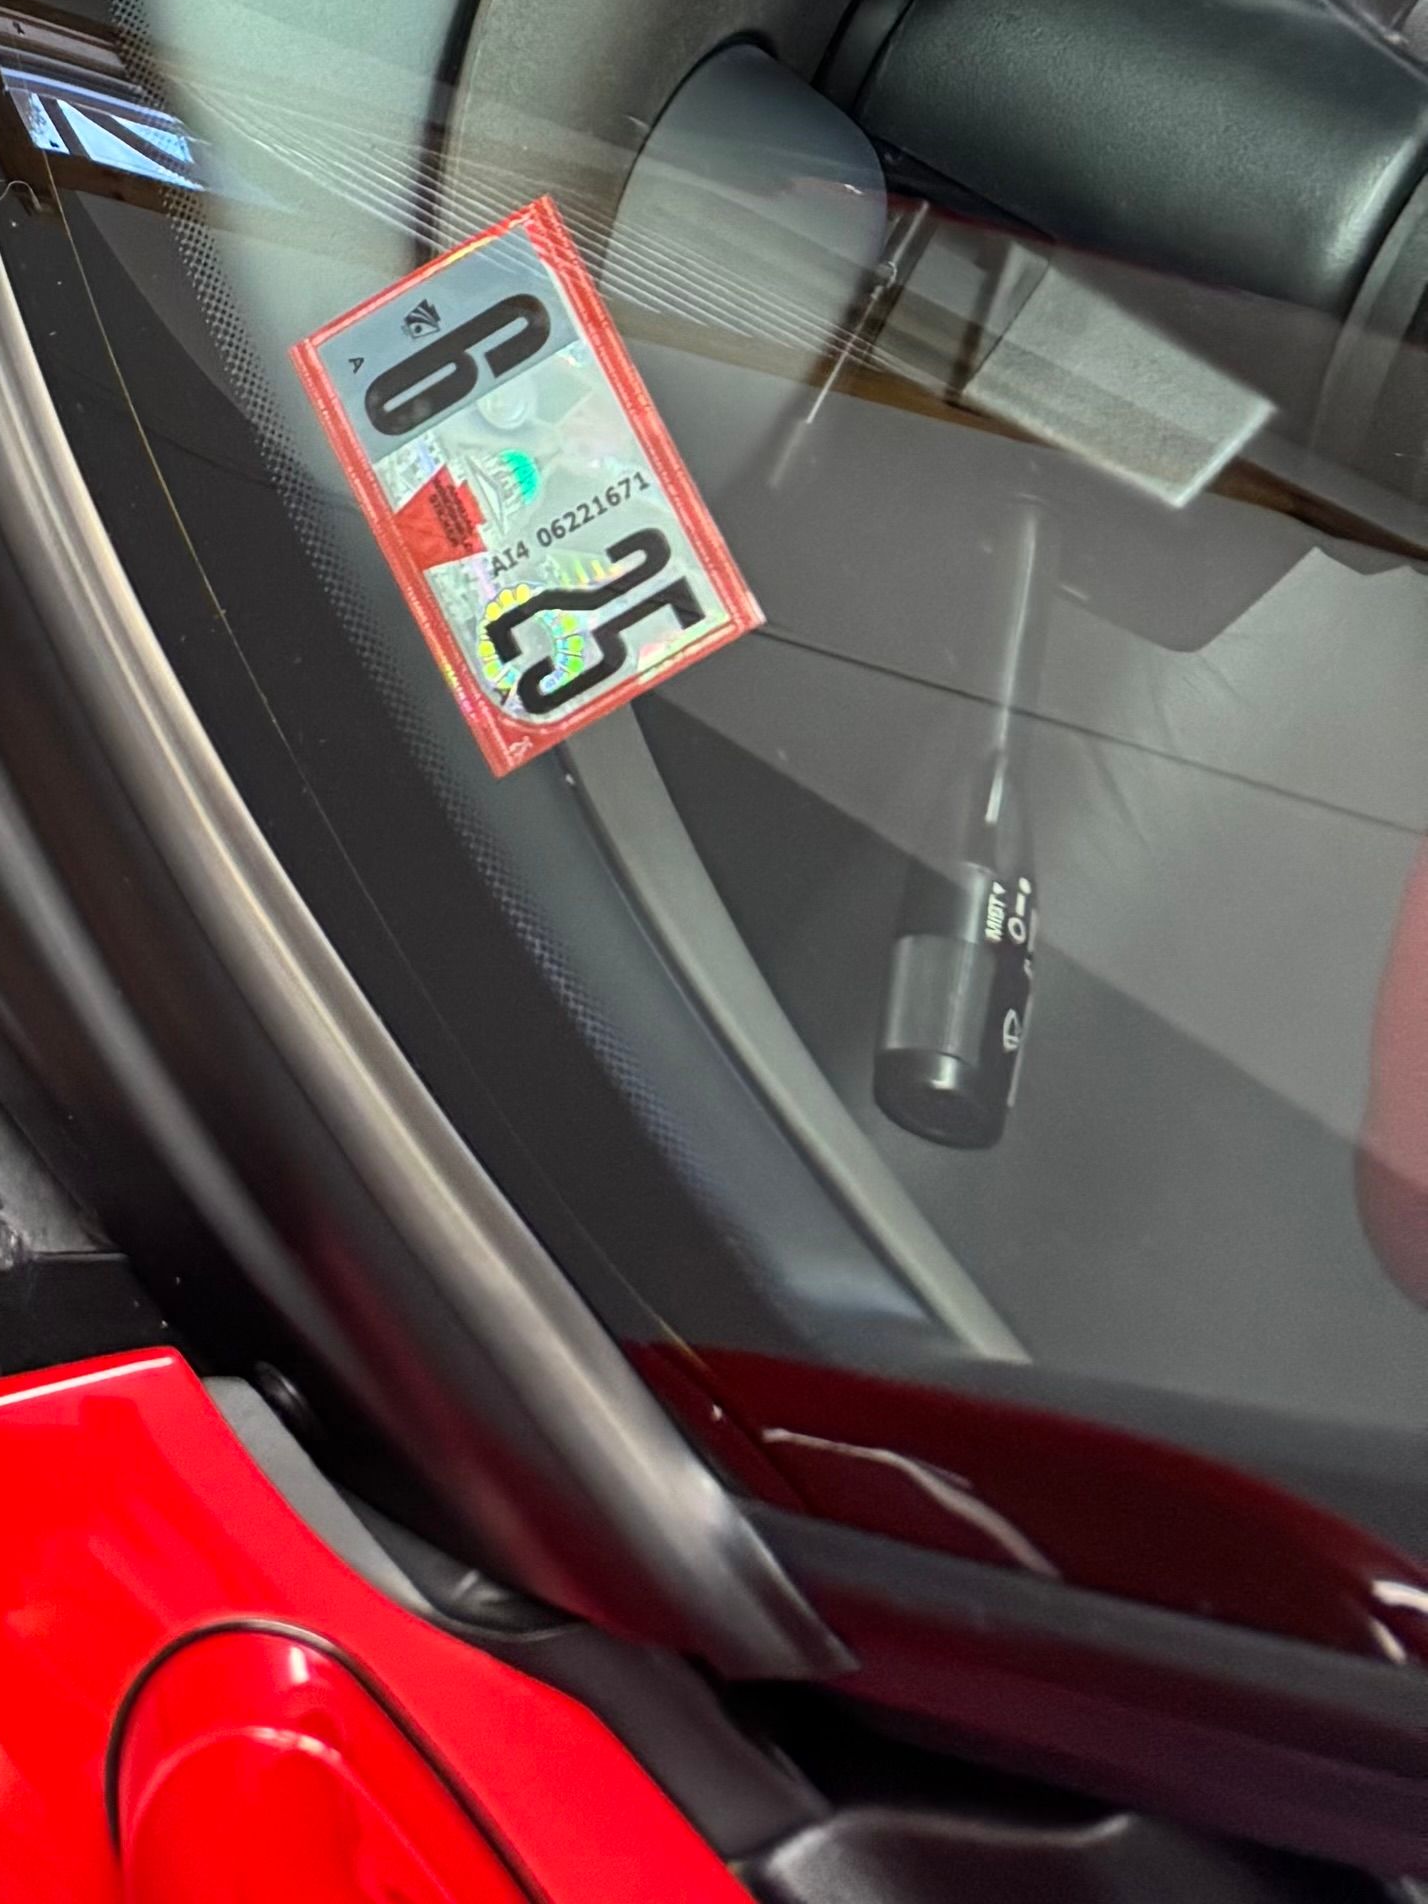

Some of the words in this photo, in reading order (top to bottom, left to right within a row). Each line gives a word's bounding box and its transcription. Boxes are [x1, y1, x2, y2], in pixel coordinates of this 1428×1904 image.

[363, 292, 552, 437] 6
[490, 545, 531, 579] AI4
[535, 471, 651, 550] 06221671
[484, 527, 706, 714] 25
